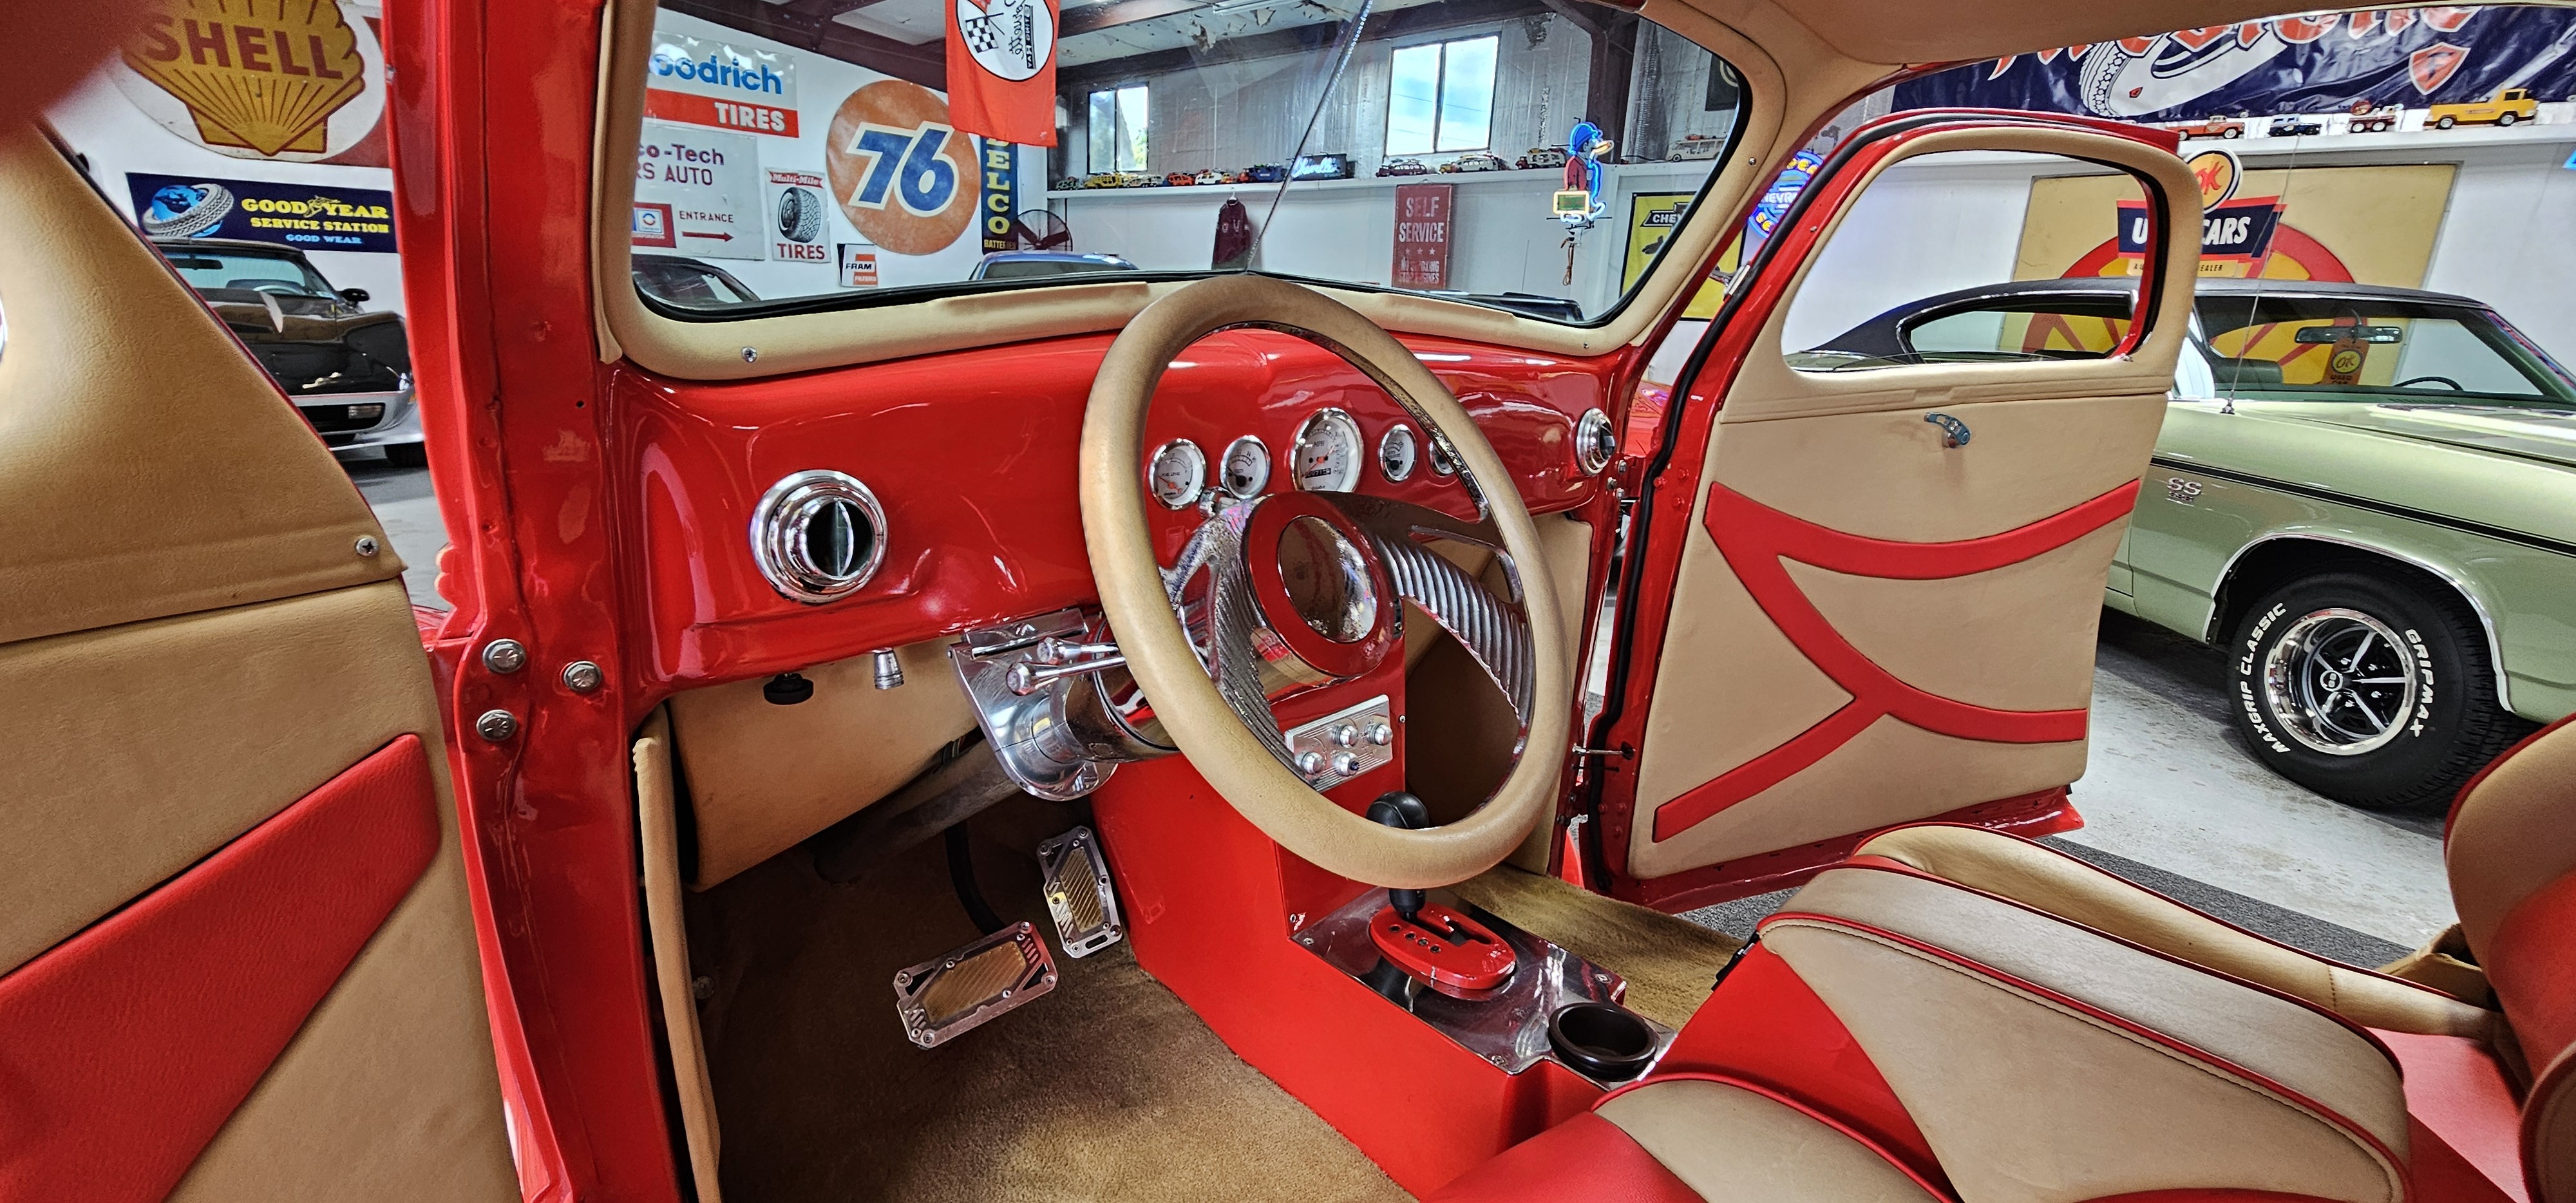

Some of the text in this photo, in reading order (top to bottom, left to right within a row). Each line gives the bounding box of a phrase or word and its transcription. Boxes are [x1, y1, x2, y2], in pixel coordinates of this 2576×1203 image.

[142, 13, 343, 80] SHELL
[652, 54, 782, 95] oodrich
[714, 101, 786, 132] TIRES
[665, 164, 713, 185] AUTO
[773, 173, 820, 185] Multi-Mile
[847, 120, 958, 217] 76
[679, 211, 734, 223] ENTRANCE
[1405, 196, 1440, 218] SELF
[249, 217, 389, 233] SERVICE STATION
[1398, 222, 1444, 243] SERVICE
[285, 234, 363, 244] GOOD WEAR
[777, 243, 825, 260] TIRES
[2167, 477, 2202, 495] SS
[2240, 602, 2291, 753] MAXGRIP CLASSIC
[2405, 629, 2434, 737] GRIPMAX
